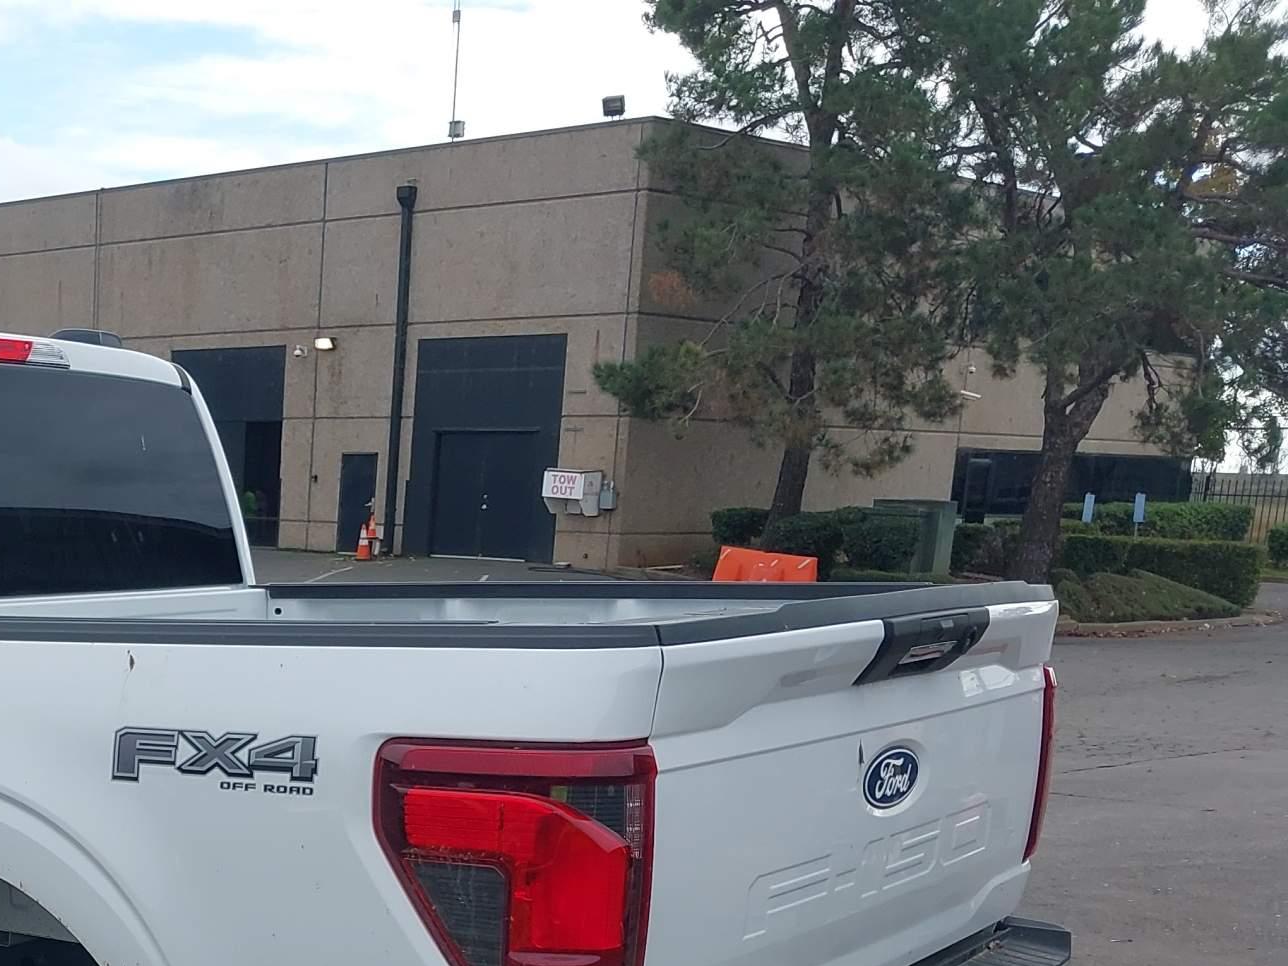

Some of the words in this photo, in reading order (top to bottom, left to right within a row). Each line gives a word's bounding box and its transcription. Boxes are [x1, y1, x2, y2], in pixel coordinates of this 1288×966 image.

[551, 485, 576, 496] OUT
[552, 474, 578, 485] TOW
[112, 727, 318, 783] FX4
[219, 780, 257, 792] OFF
[263, 783, 314, 796] ROAD
[875, 757, 912, 799] Ford
[742, 799, 992, 941] F-150
